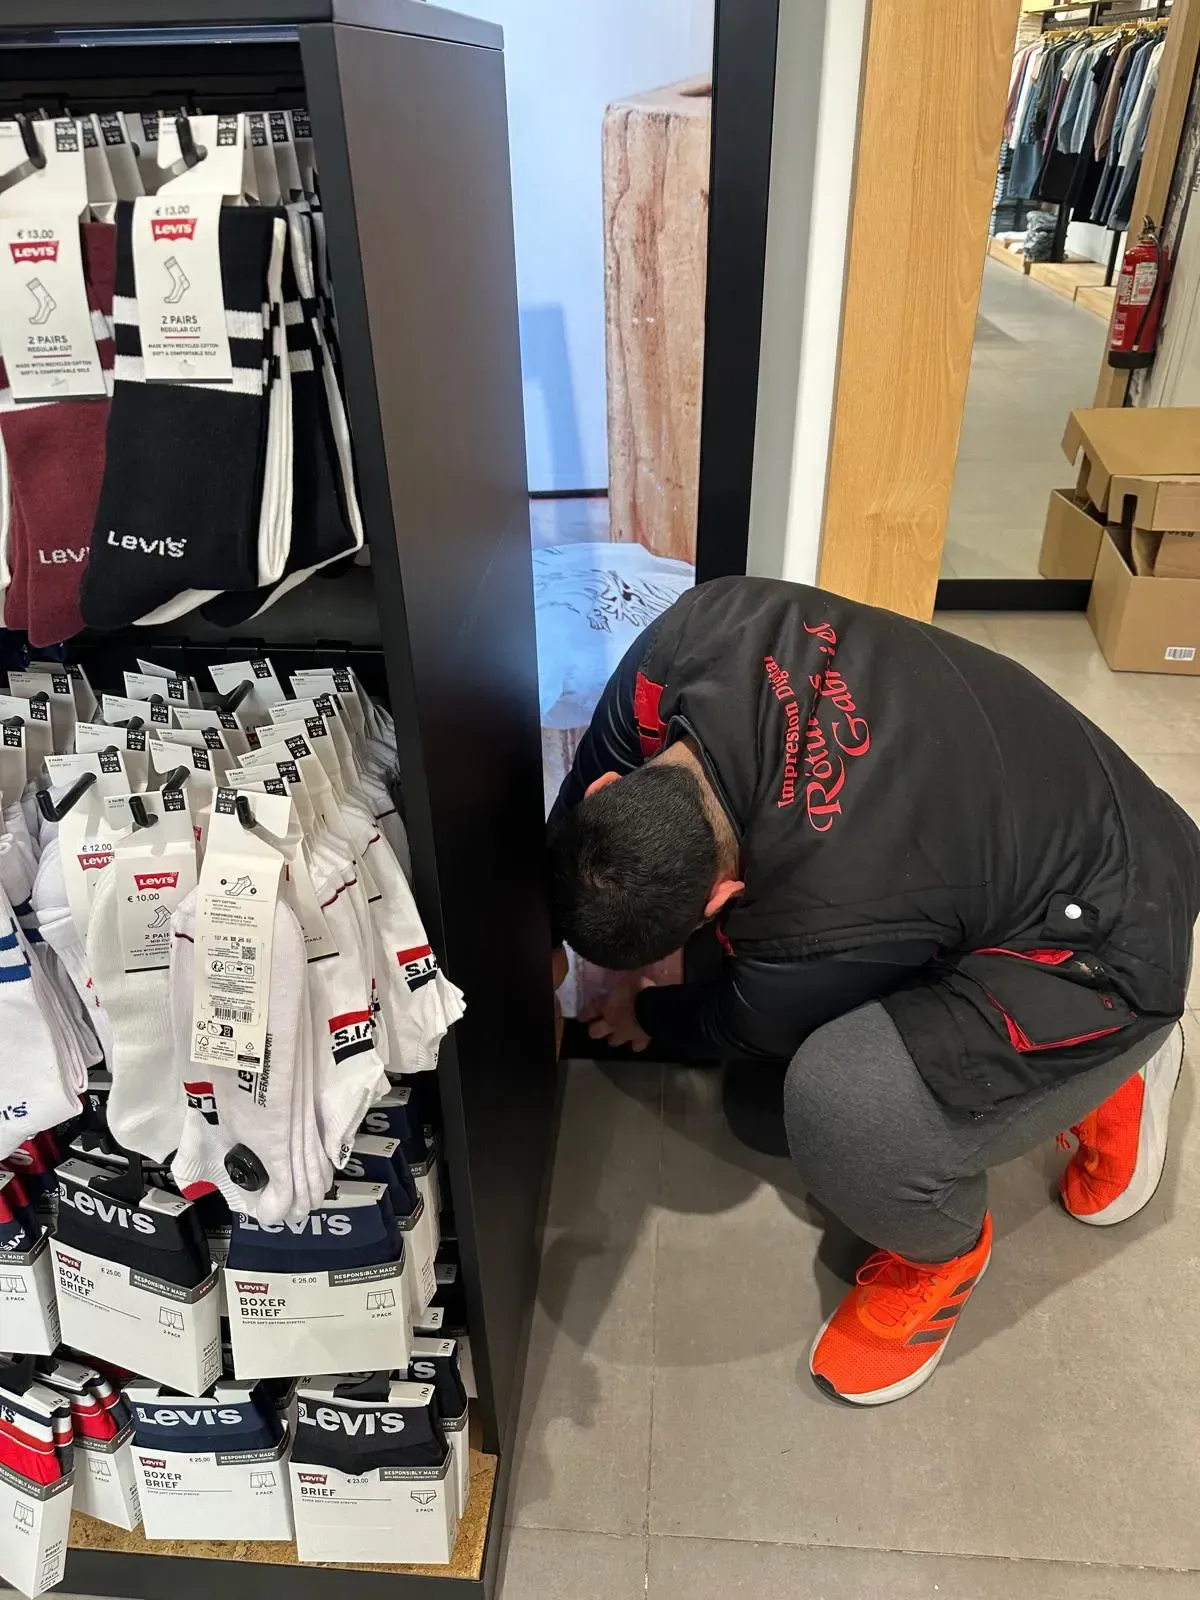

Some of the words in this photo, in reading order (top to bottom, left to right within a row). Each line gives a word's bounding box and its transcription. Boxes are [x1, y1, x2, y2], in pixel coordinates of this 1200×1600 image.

[164, 205, 190, 215] 13.00
[17, 230, 24, 239] €
[27, 229, 54, 239] 13.00
[162, 315, 168, 325] 2
[170, 315, 198, 324] PAIRS
[28, 336, 35, 345] 2
[38, 335, 69, 345] PAIRS
[27, 345, 58, 353] REGULAR
[39, 547, 90, 564] Lev
[776, 701, 800, 808] Impresion
[804, 673, 846, 832] Rótus
[217, 793, 236, 801] 43-46
[90, 843, 112, 852] 12.00
[136, 893, 160, 902] 10.00
[400, 1089, 407, 1097] 2
[175, 1201, 186, 1209] 2
[59, 1266, 95, 1289] BOXER
[106, 1269, 122, 1278] 25.00
[333, 1269, 378, 1280] RESPONSIBLY
[60, 1276, 91, 1296] BRIEF
[133, 1273, 171, 1293] RESPONSIBLY
[170, 1288, 187, 1297] MADE
[239, 1296, 287, 1307] BOXER
[241, 1307, 282, 1317] BRIEF
[431, 1312, 439, 1321] 2
[421, 1387, 430, 1395] 2
[220, 1453, 258, 1461] RESPONSIBLY
[143, 1469, 182, 1481] BOXER
[27, 1483, 41, 1494] MADE
[145, 1479, 179, 1489] BRIEF
[300, 1486, 336, 1497] BRIEF
